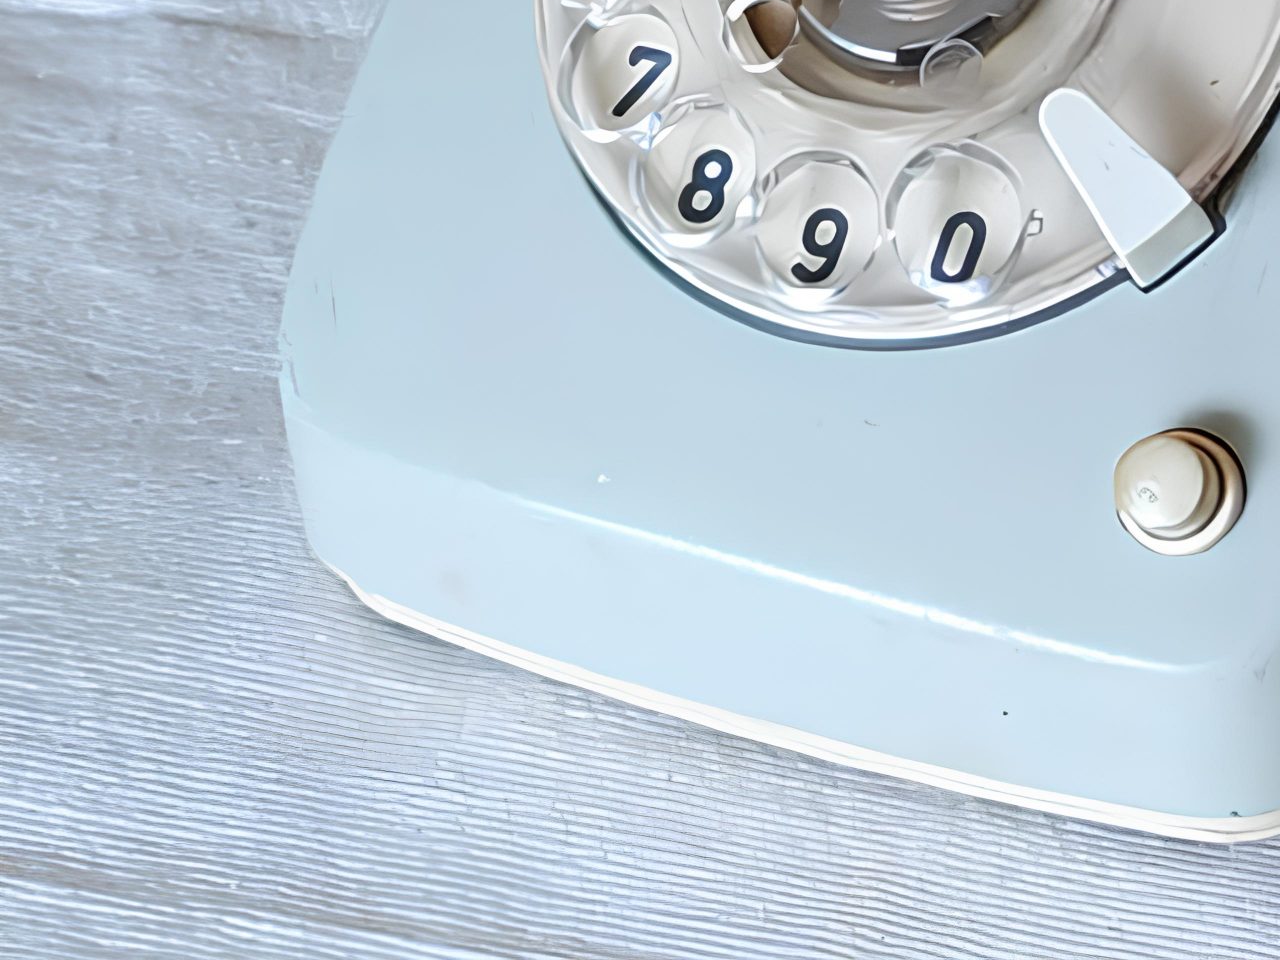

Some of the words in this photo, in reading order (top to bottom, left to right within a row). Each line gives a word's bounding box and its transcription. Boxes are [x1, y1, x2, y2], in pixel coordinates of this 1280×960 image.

[612, 45, 672, 118] 7
[678, 149, 733, 224] 8
[791, 208, 849, 284] 9
[930, 211, 987, 283] 0
